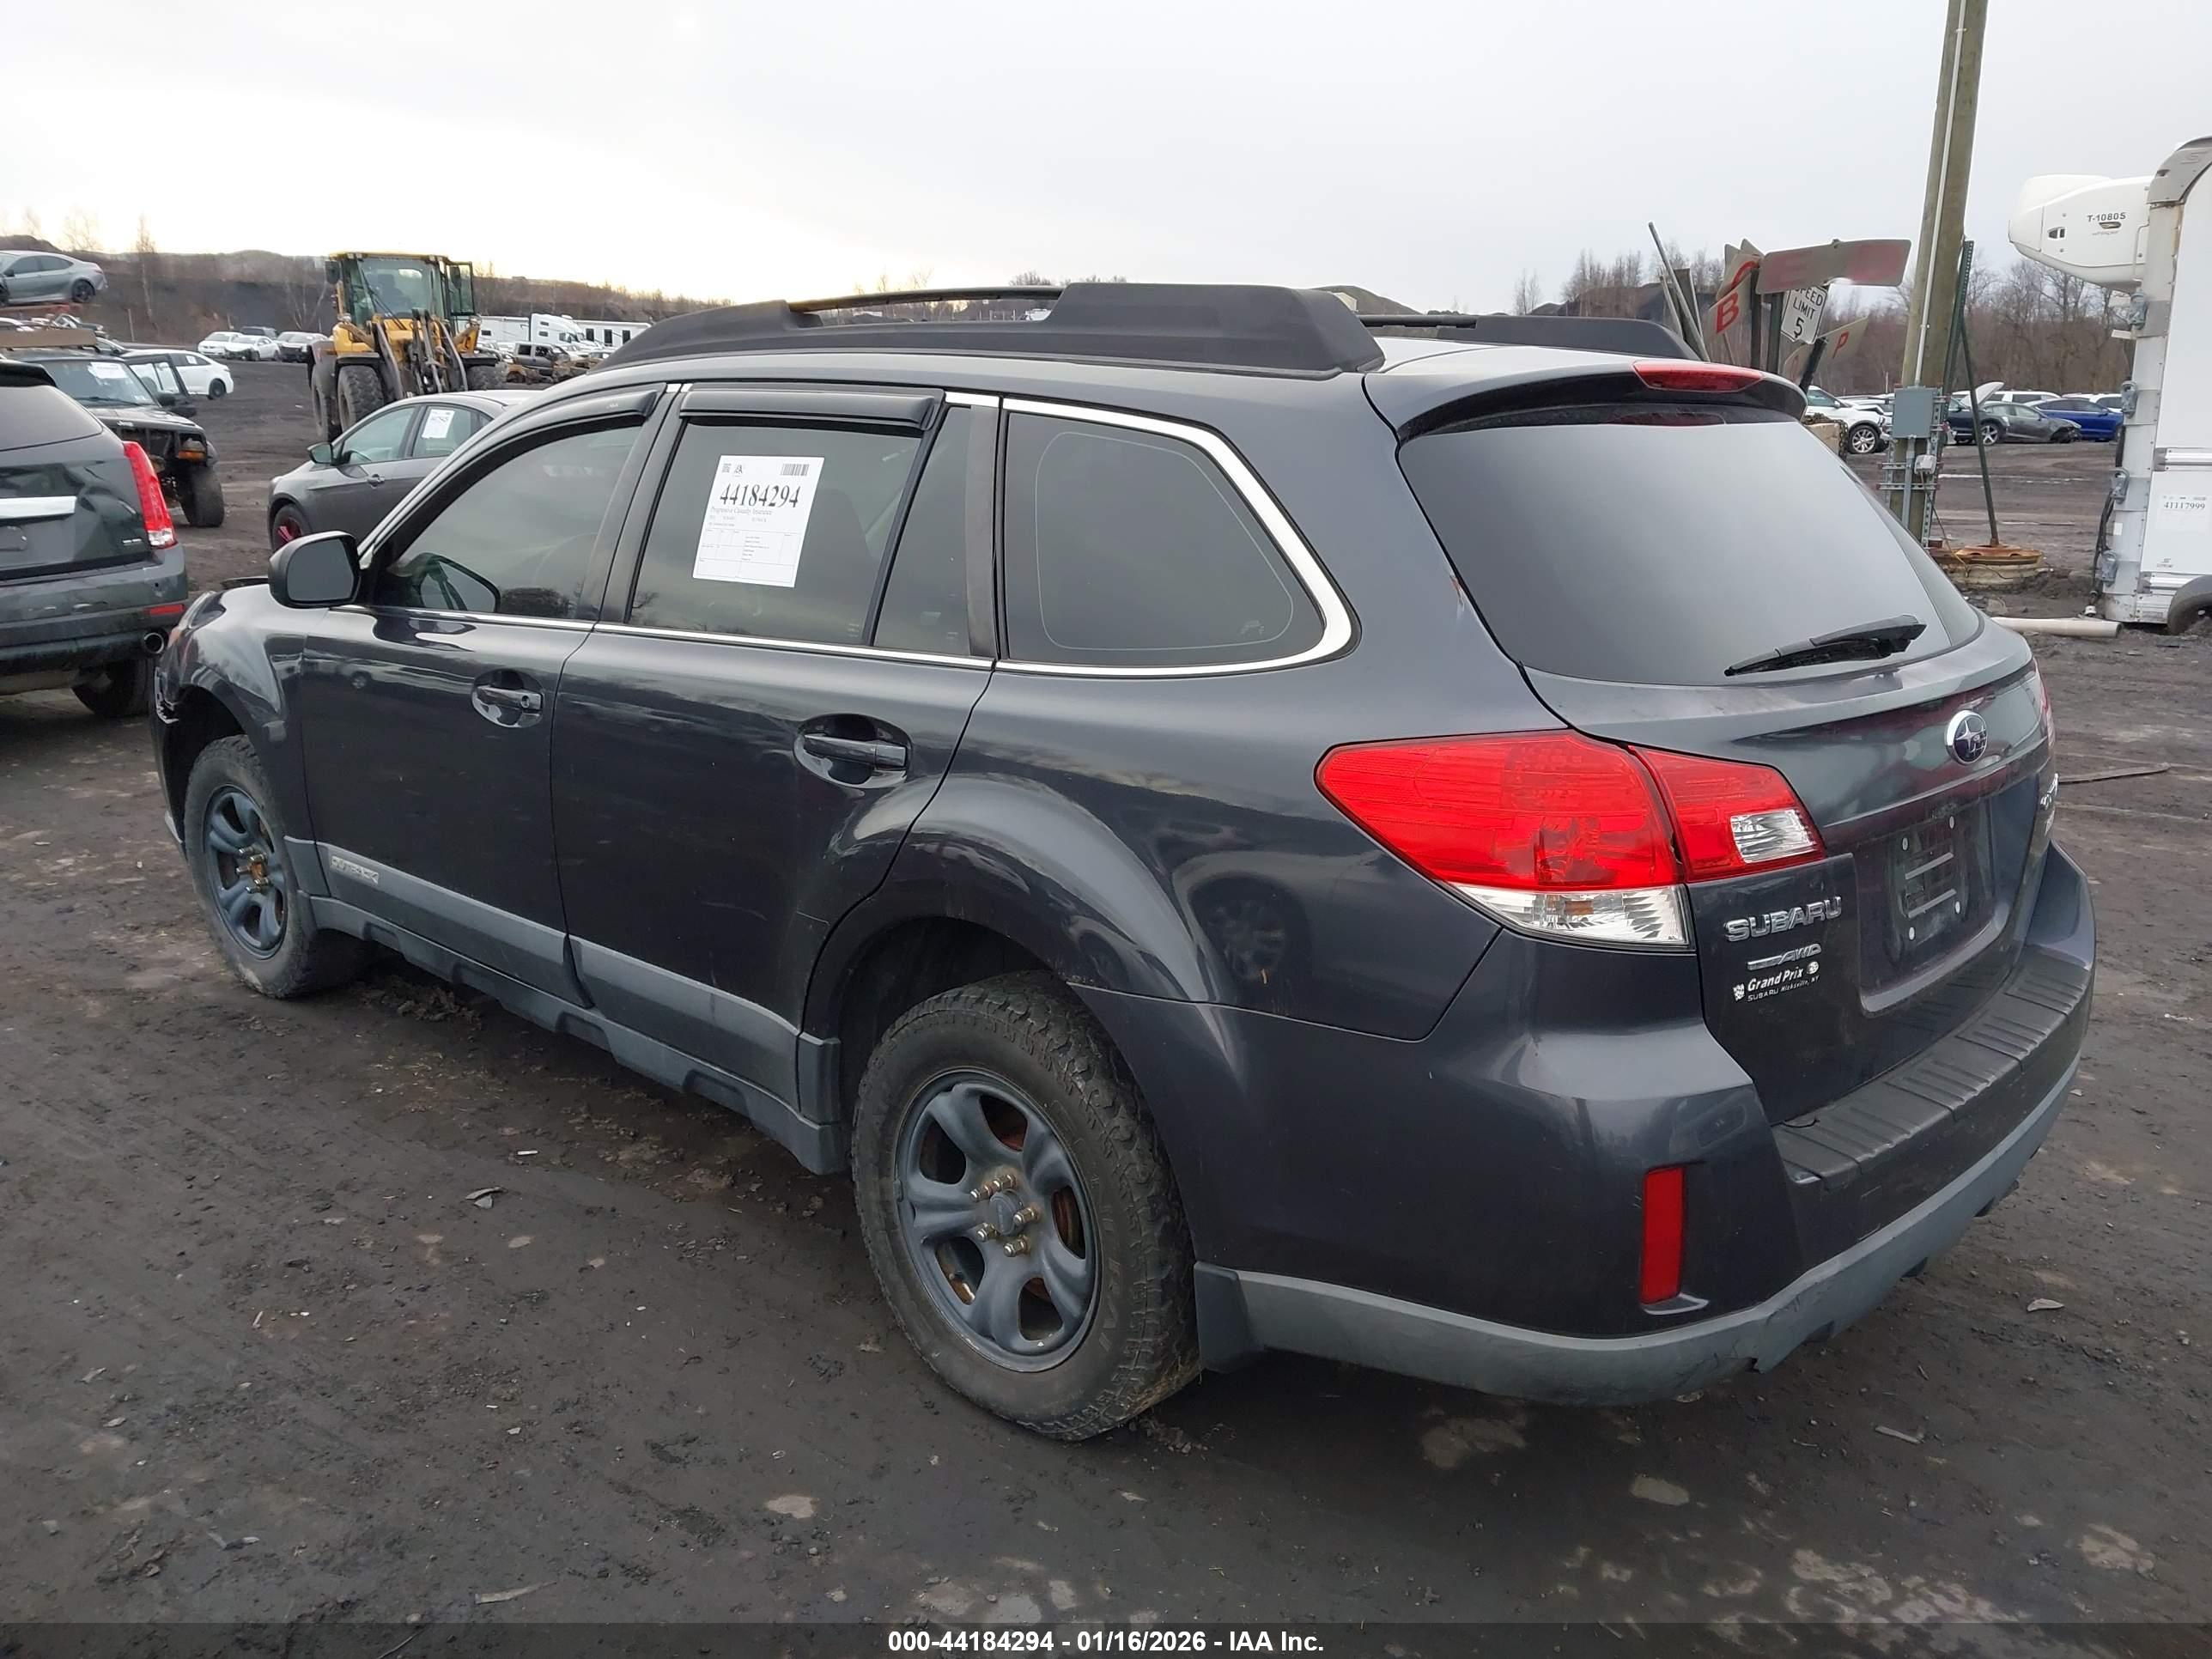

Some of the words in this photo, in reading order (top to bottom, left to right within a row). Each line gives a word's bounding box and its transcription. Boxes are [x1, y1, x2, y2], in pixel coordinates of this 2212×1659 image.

[1796, 288, 1823, 306] PEED
[1793, 297, 1816, 319] LIMIT
[1794, 317, 1804, 337] 5
[720, 483, 800, 507] 44184294
[1723, 896, 1842, 942] SUBARU
[1778, 943, 1822, 964] AWD
[1747, 971, 1783, 992] Grand
[1782, 966, 1804, 982] Prix
[1747, 988, 1779, 1002] SUBARU
